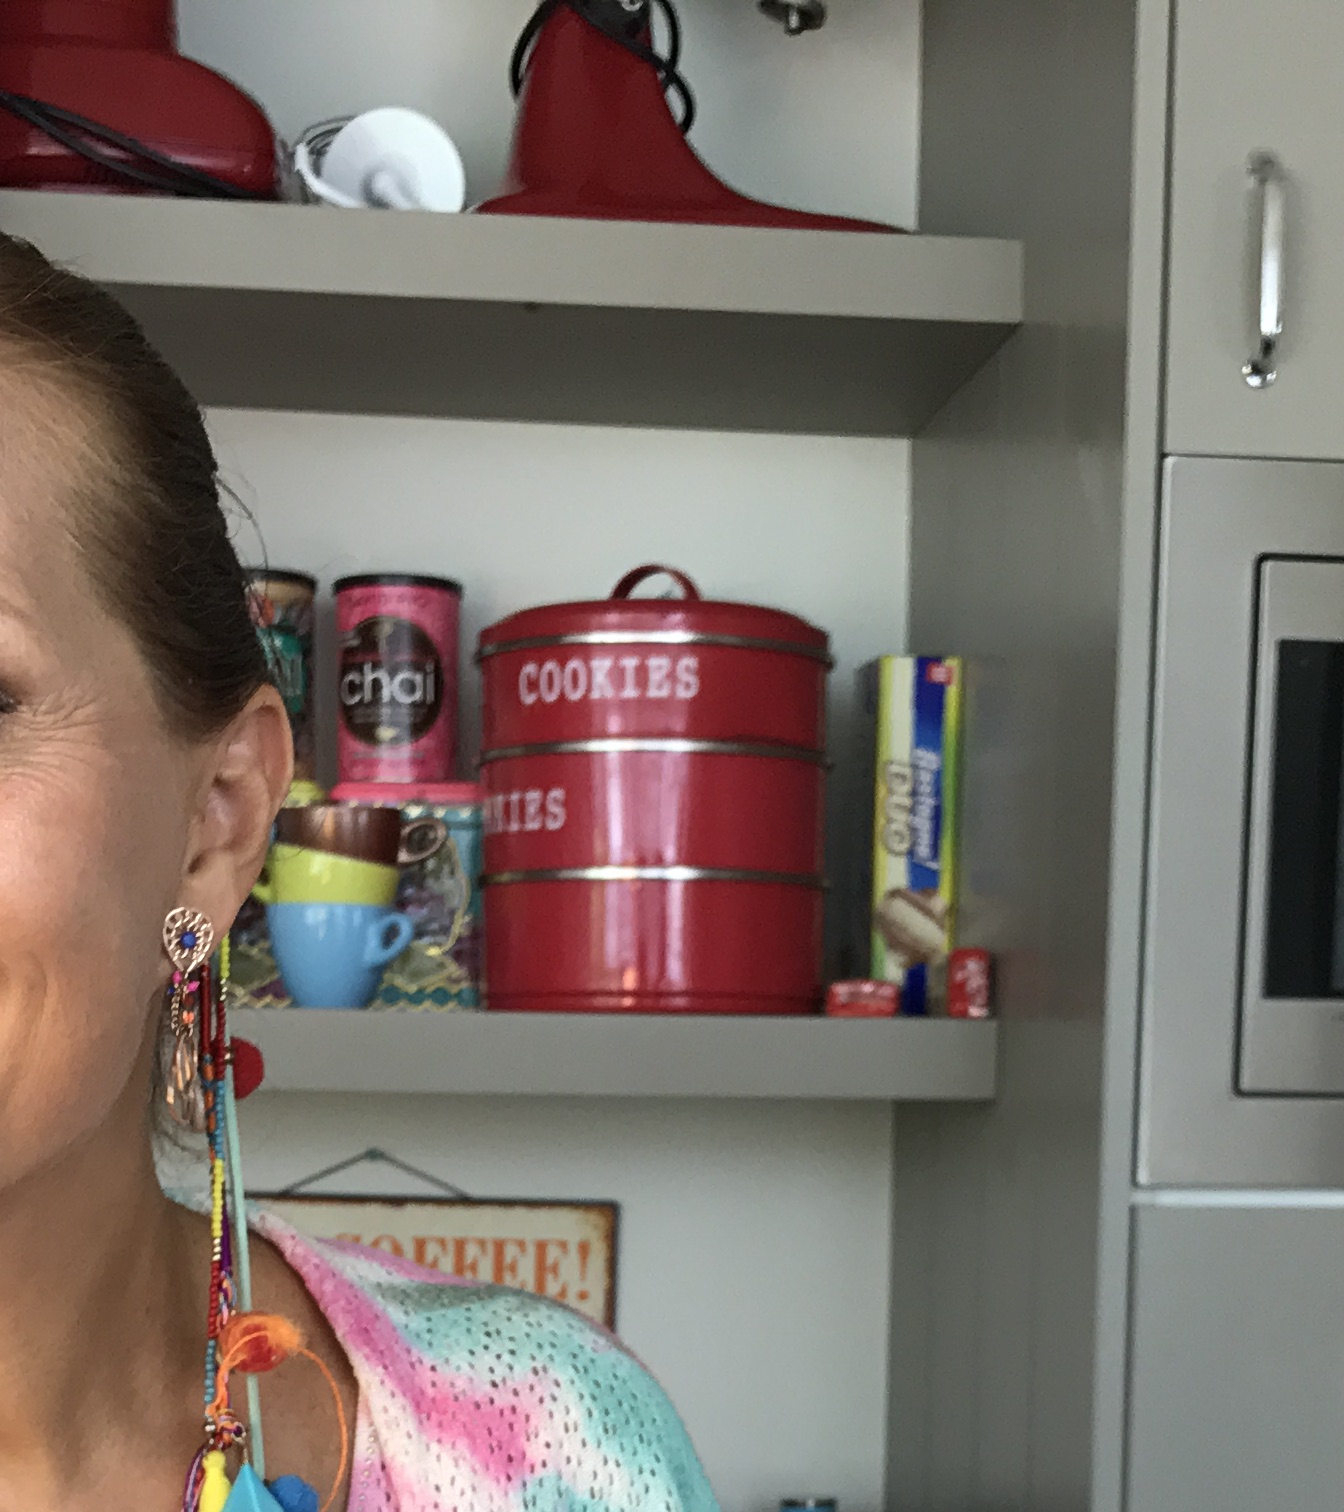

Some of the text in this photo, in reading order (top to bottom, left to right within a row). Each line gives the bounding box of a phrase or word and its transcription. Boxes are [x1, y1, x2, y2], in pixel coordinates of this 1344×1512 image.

[340, 661, 436, 705] chai
[518, 656, 700, 705] COOKIES
[337, 1232, 591, 1301] FFEE!
